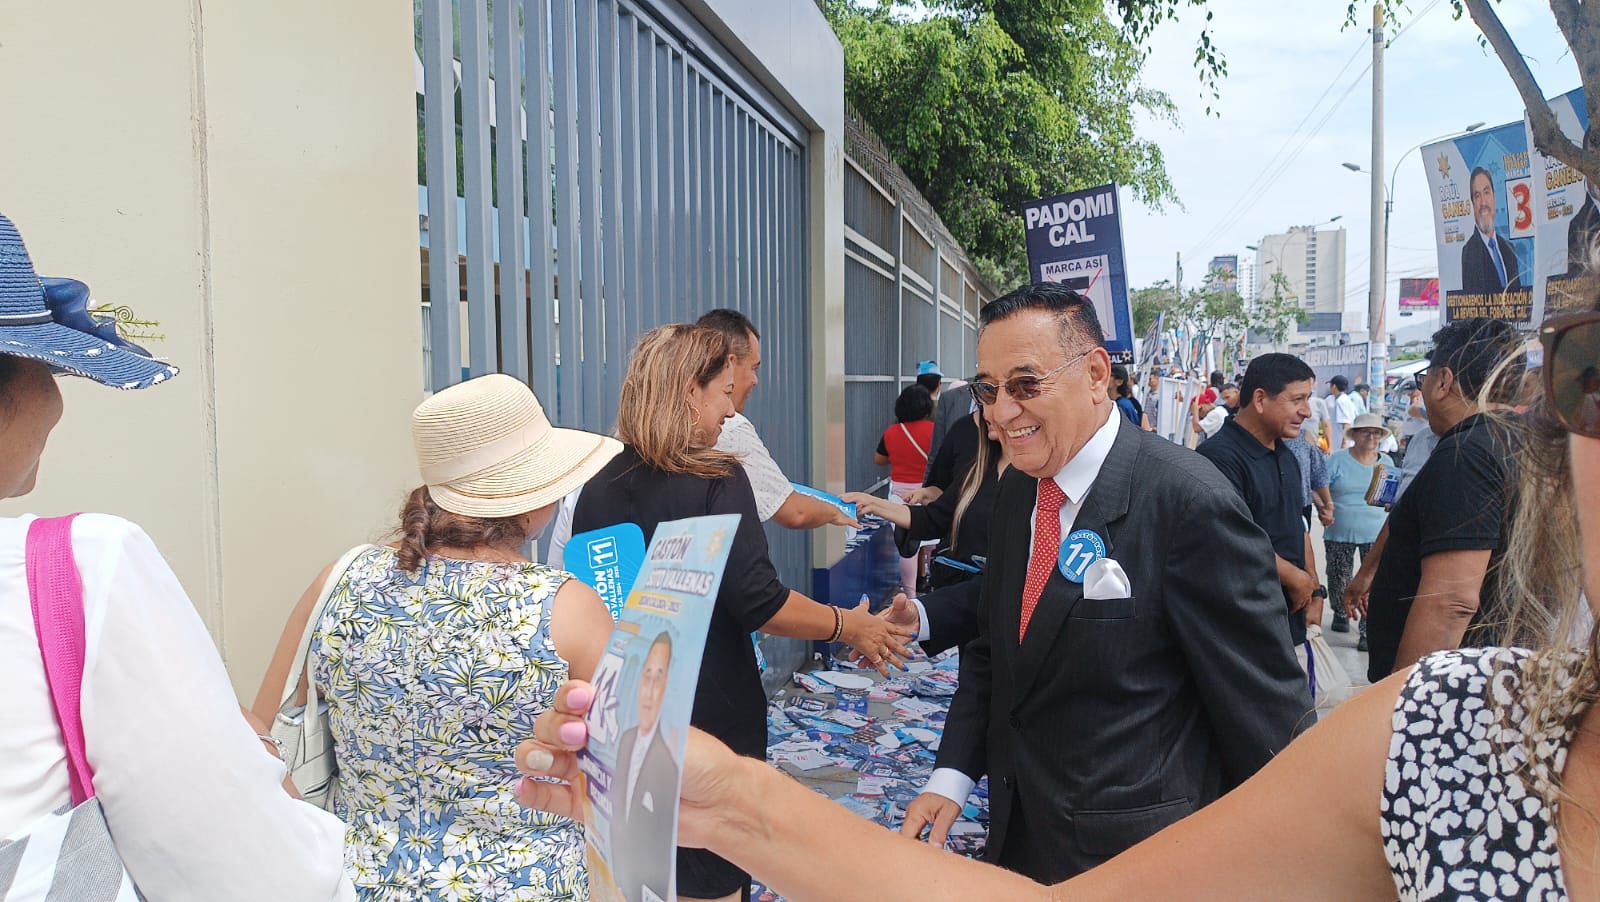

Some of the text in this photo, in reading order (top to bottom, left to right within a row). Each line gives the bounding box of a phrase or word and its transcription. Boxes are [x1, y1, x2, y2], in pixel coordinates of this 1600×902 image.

[1025, 191, 1114, 230] PADOMI
[1512, 183, 1532, 230] 3
[1049, 222, 1095, 247] CAL
[1046, 259, 1082, 275] MARCA
[592, 541, 614, 564] 11
[1065, 543, 1095, 576] 11
